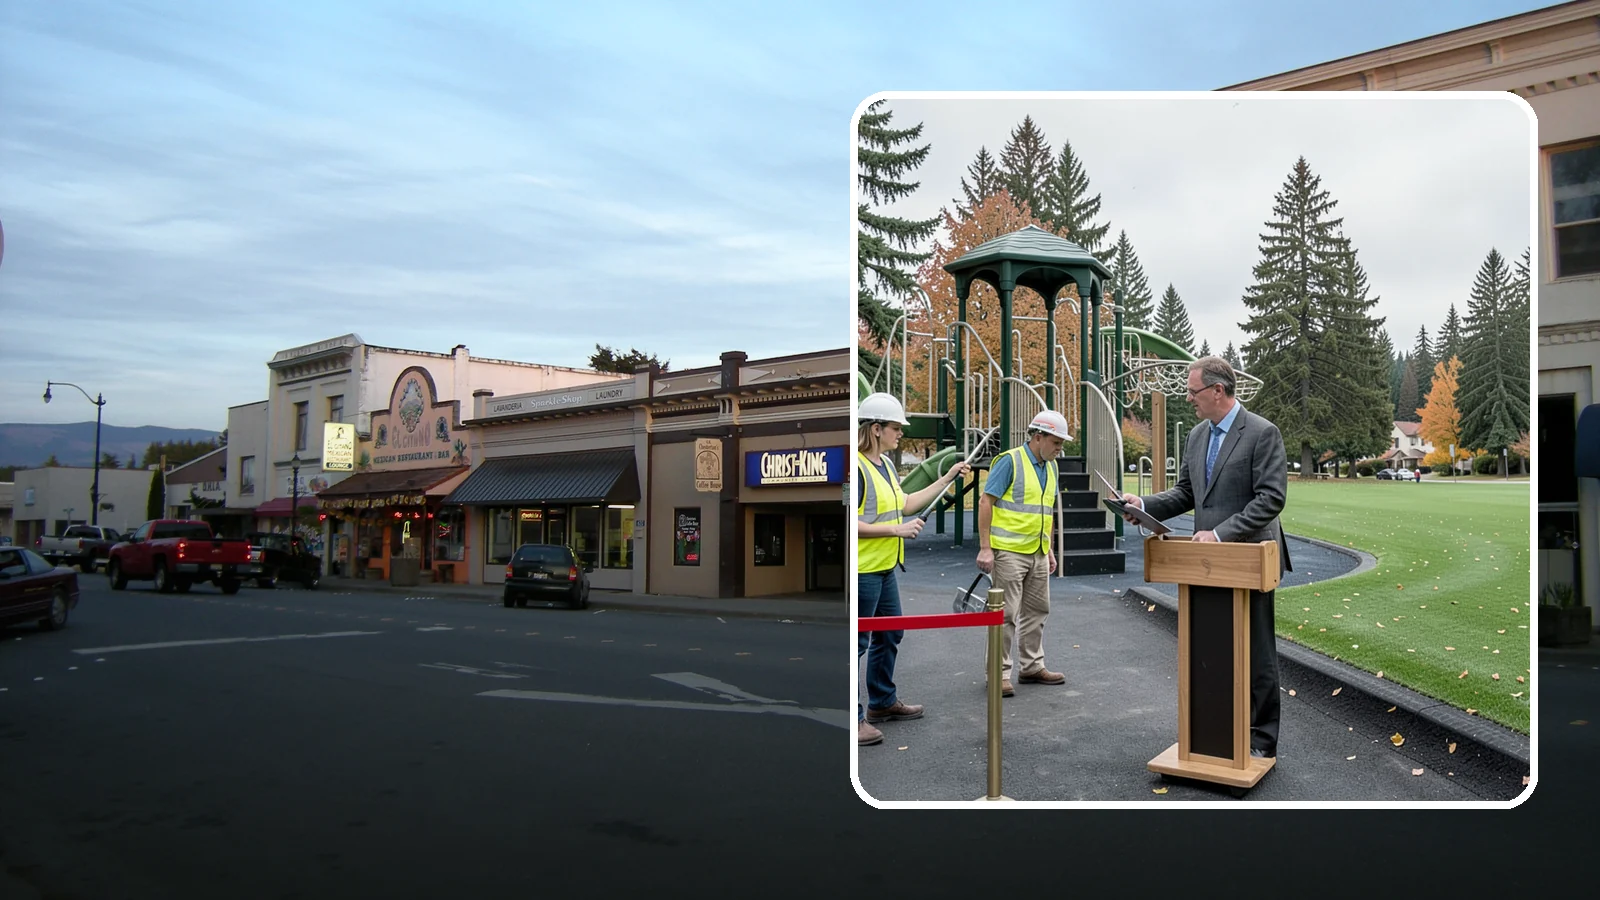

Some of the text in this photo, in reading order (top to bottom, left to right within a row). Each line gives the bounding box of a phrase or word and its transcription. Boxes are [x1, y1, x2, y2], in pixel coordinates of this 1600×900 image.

[596, 389, 623, 399] LAUNDRY
[493, 402, 522, 412] LAVANDERIA
[373, 455, 396, 464] MEXICAN
[398, 451, 433, 462] RESTAURANT
[438, 450, 450, 459] BAR
[761, 450, 828, 478] CHRIST KING
